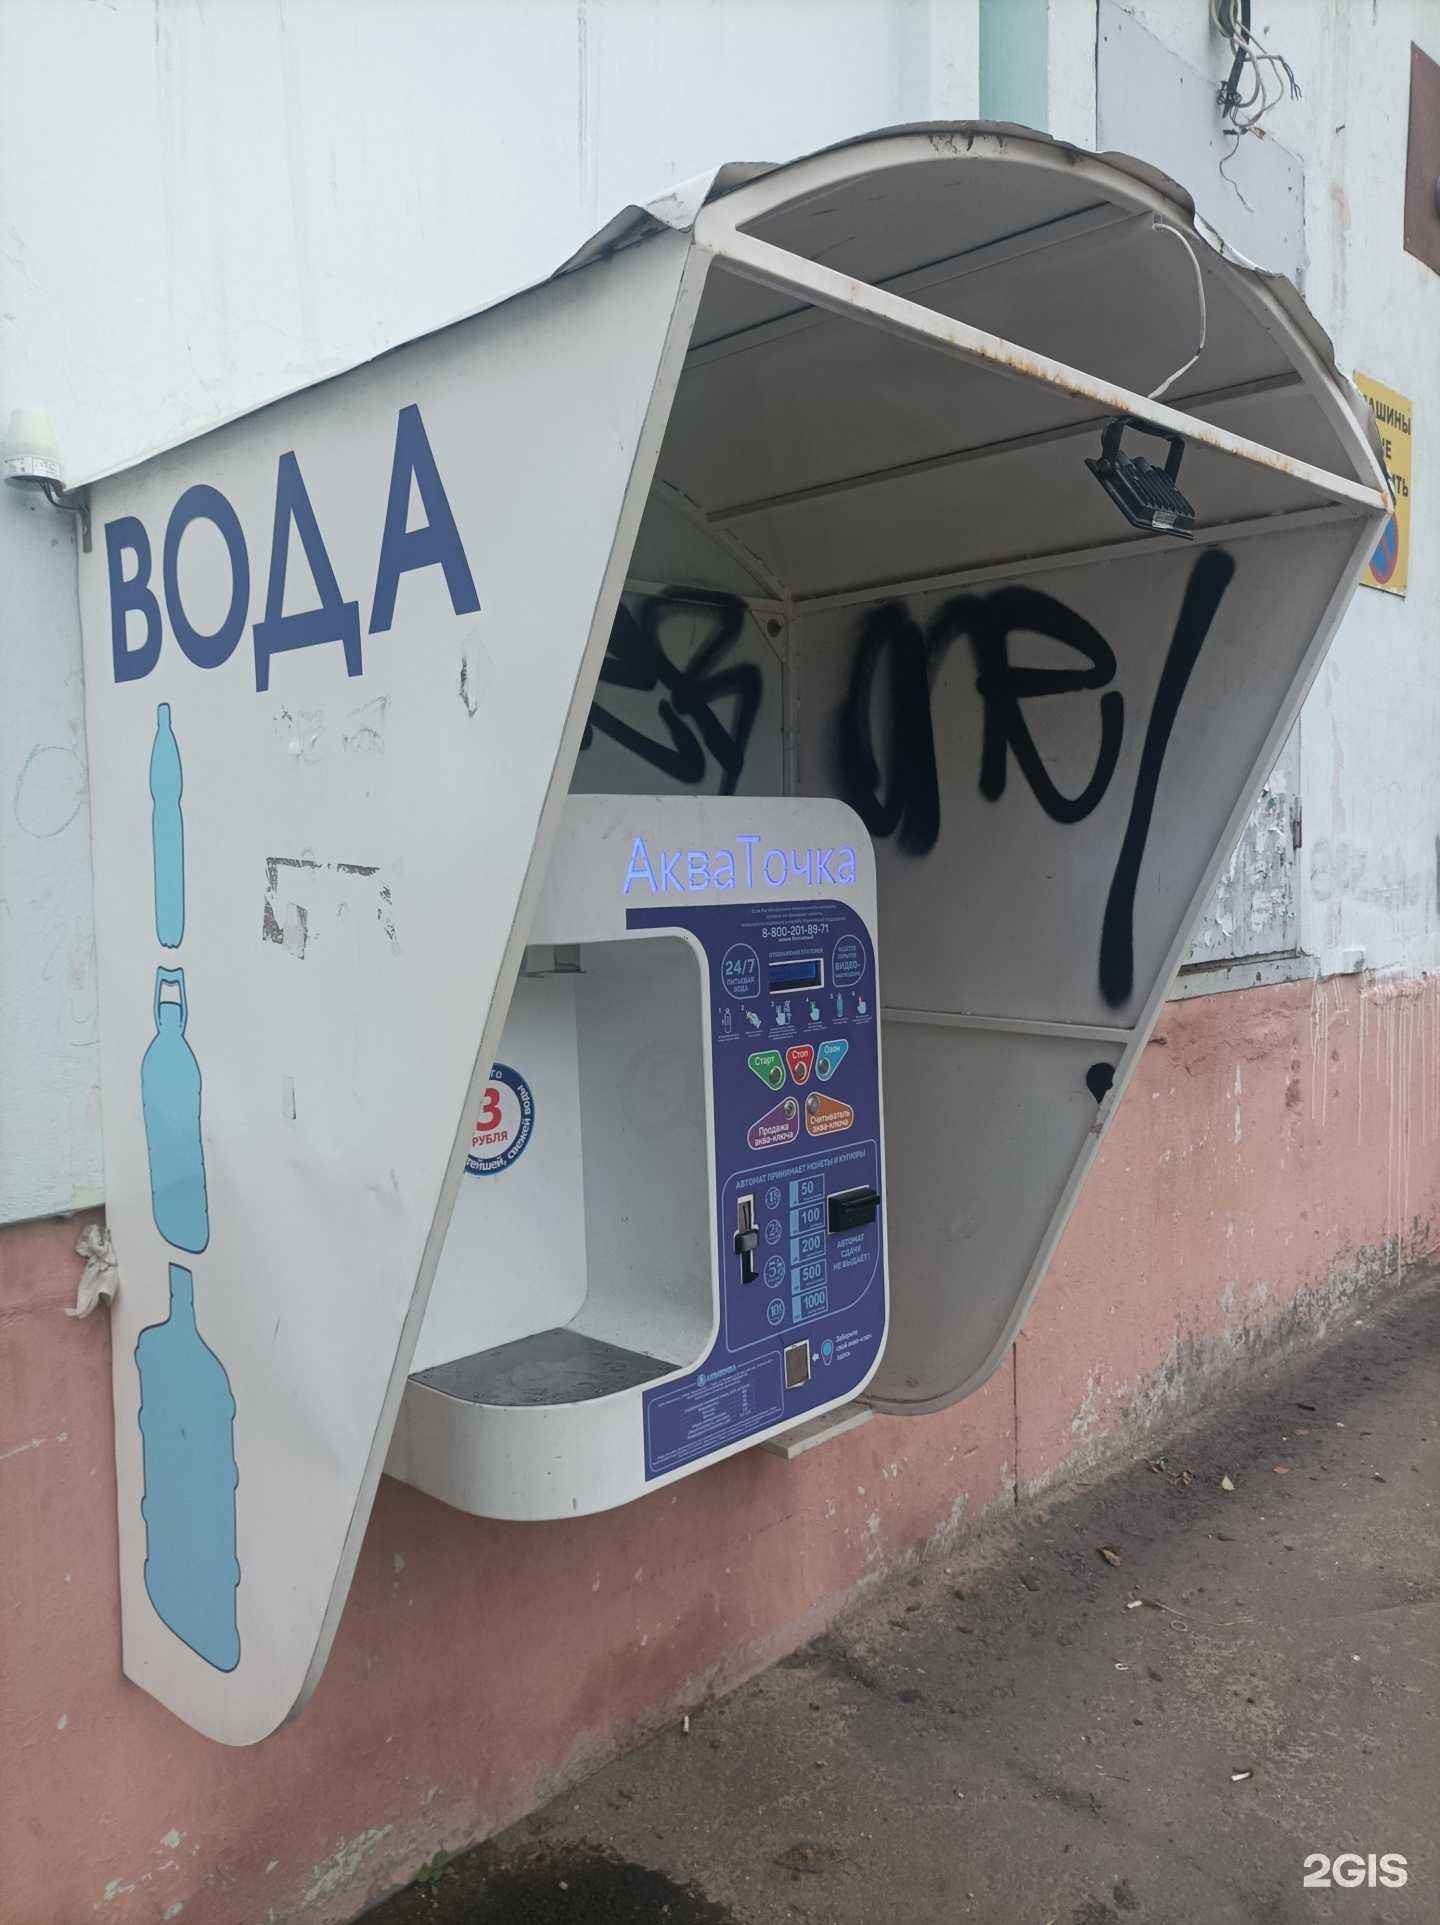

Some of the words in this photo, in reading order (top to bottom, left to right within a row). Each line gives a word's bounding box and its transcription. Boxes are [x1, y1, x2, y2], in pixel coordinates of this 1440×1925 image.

[1363, 394, 1411, 436] АШИНЫ
[105, 404, 481, 692] ВОДА
[623, 835, 857, 894] АкваТочка
[762, 924, 829, 938] 8-800-201-89-71
[725, 959, 755, 976] 24/7
[755, 1056, 775, 1066] Старт
[792, 1050, 808, 1060] Стоп
[476, 1088, 502, 1132] 3
[472, 1131, 508, 1148] РУБЛЯ
[801, 1181, 814, 1195] 50
[801, 1208, 820, 1224] 100
[801, 1236, 821, 1252] 200
[802, 1264, 821, 1281] 500
[803, 1291, 825, 1309] 1000
